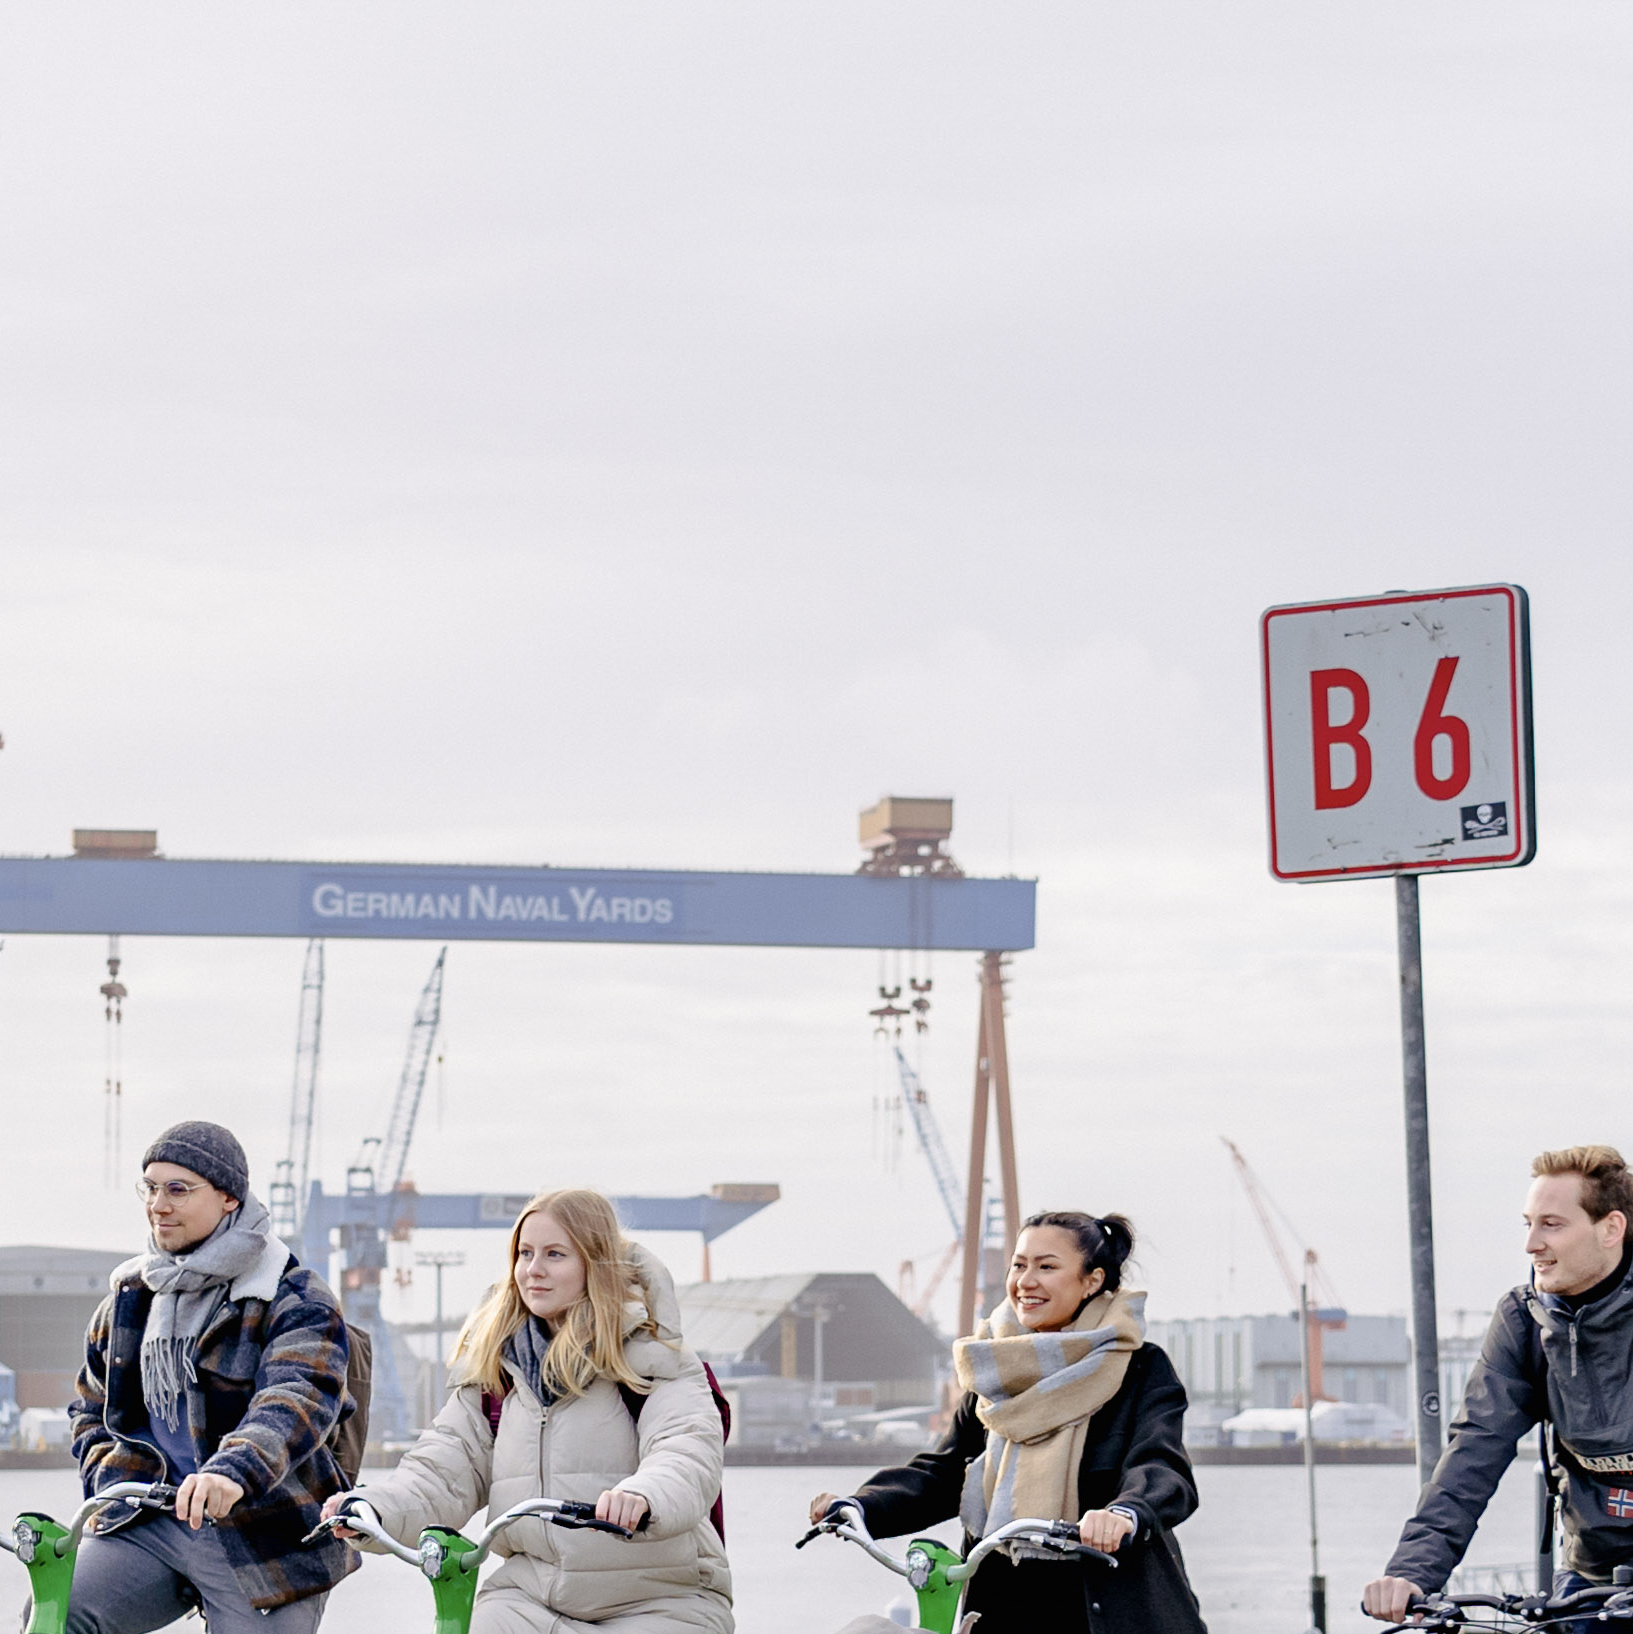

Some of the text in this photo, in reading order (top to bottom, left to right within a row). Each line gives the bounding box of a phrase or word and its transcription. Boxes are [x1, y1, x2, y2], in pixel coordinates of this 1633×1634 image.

[1310, 656, 1471, 810] B 6
[312, 883, 673, 923] GERMAN NAVAL YARDS
